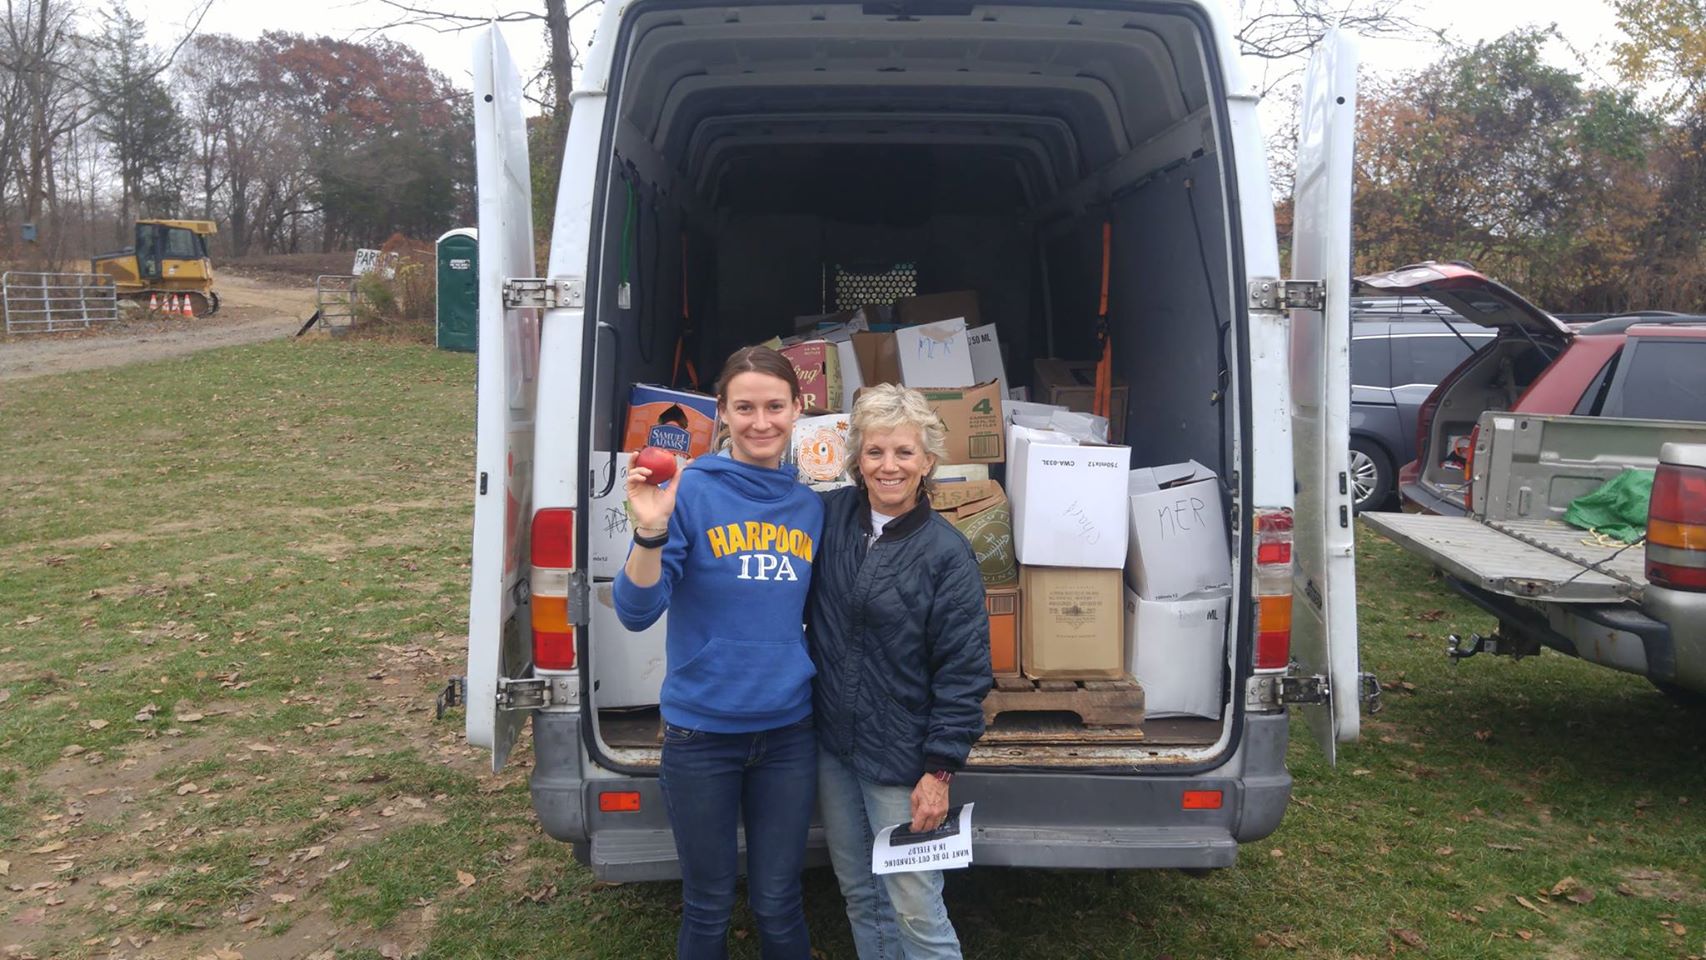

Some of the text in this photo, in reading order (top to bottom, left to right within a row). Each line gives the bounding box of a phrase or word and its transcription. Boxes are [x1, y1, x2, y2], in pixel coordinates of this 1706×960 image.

[972, 398, 993, 414] 4
[652, 429, 686, 444] SAMUEL
[654, 438, 683, 450] ADAMS
[707, 521, 813, 563] HARPOON
[737, 553, 799, 581] IPA
[1206, 609, 1219, 620] ML
[908, 845, 931, 856] FIELD?
[939, 843, 946, 851] IN
[941, 852, 950, 860] TO
[952, 849, 970, 858] WANT
